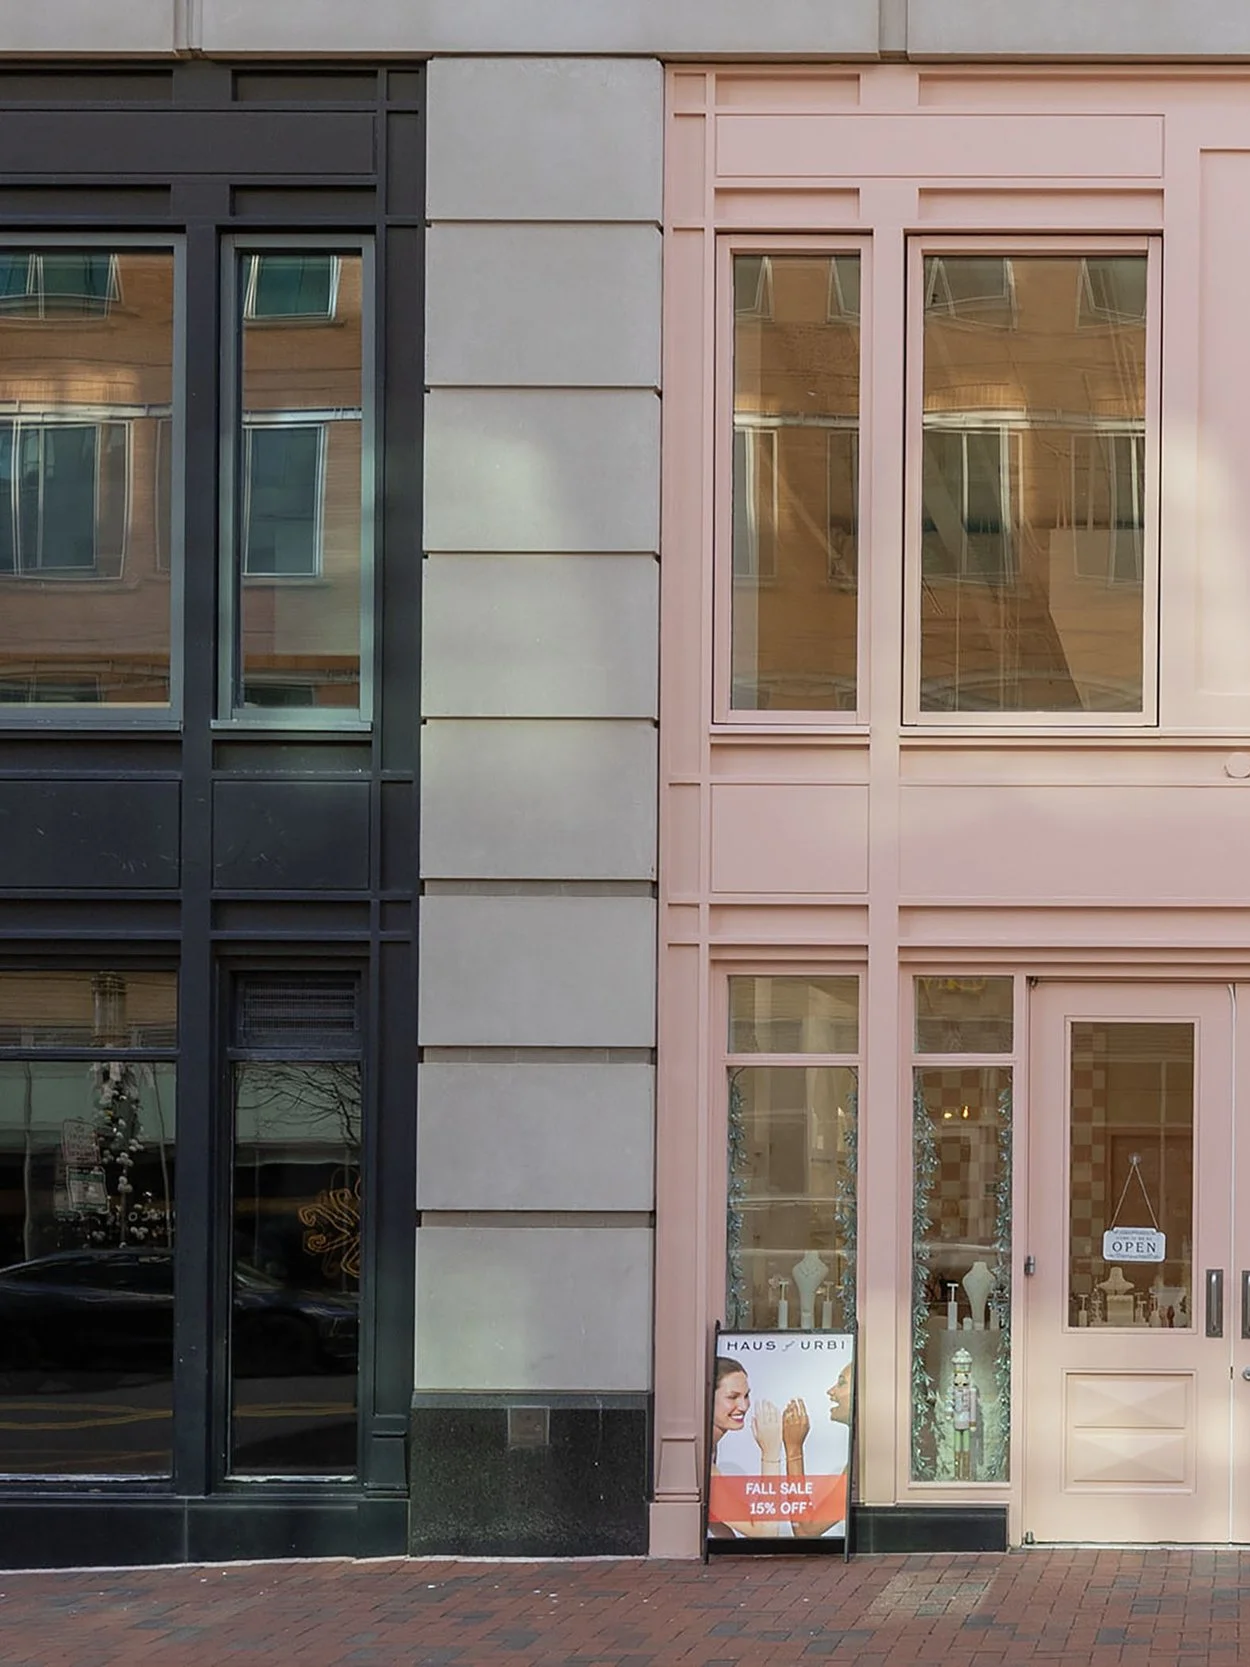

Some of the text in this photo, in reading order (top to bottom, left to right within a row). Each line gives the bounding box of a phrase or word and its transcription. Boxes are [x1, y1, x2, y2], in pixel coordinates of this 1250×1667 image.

[1112, 1241, 1156, 1252] OPEN
[727, 1340, 776, 1351] HAUS
[800, 1340, 845, 1350] URBI
[745, 1482, 813, 1495] FALL SALE
[750, 1502, 776, 1515] 15%
